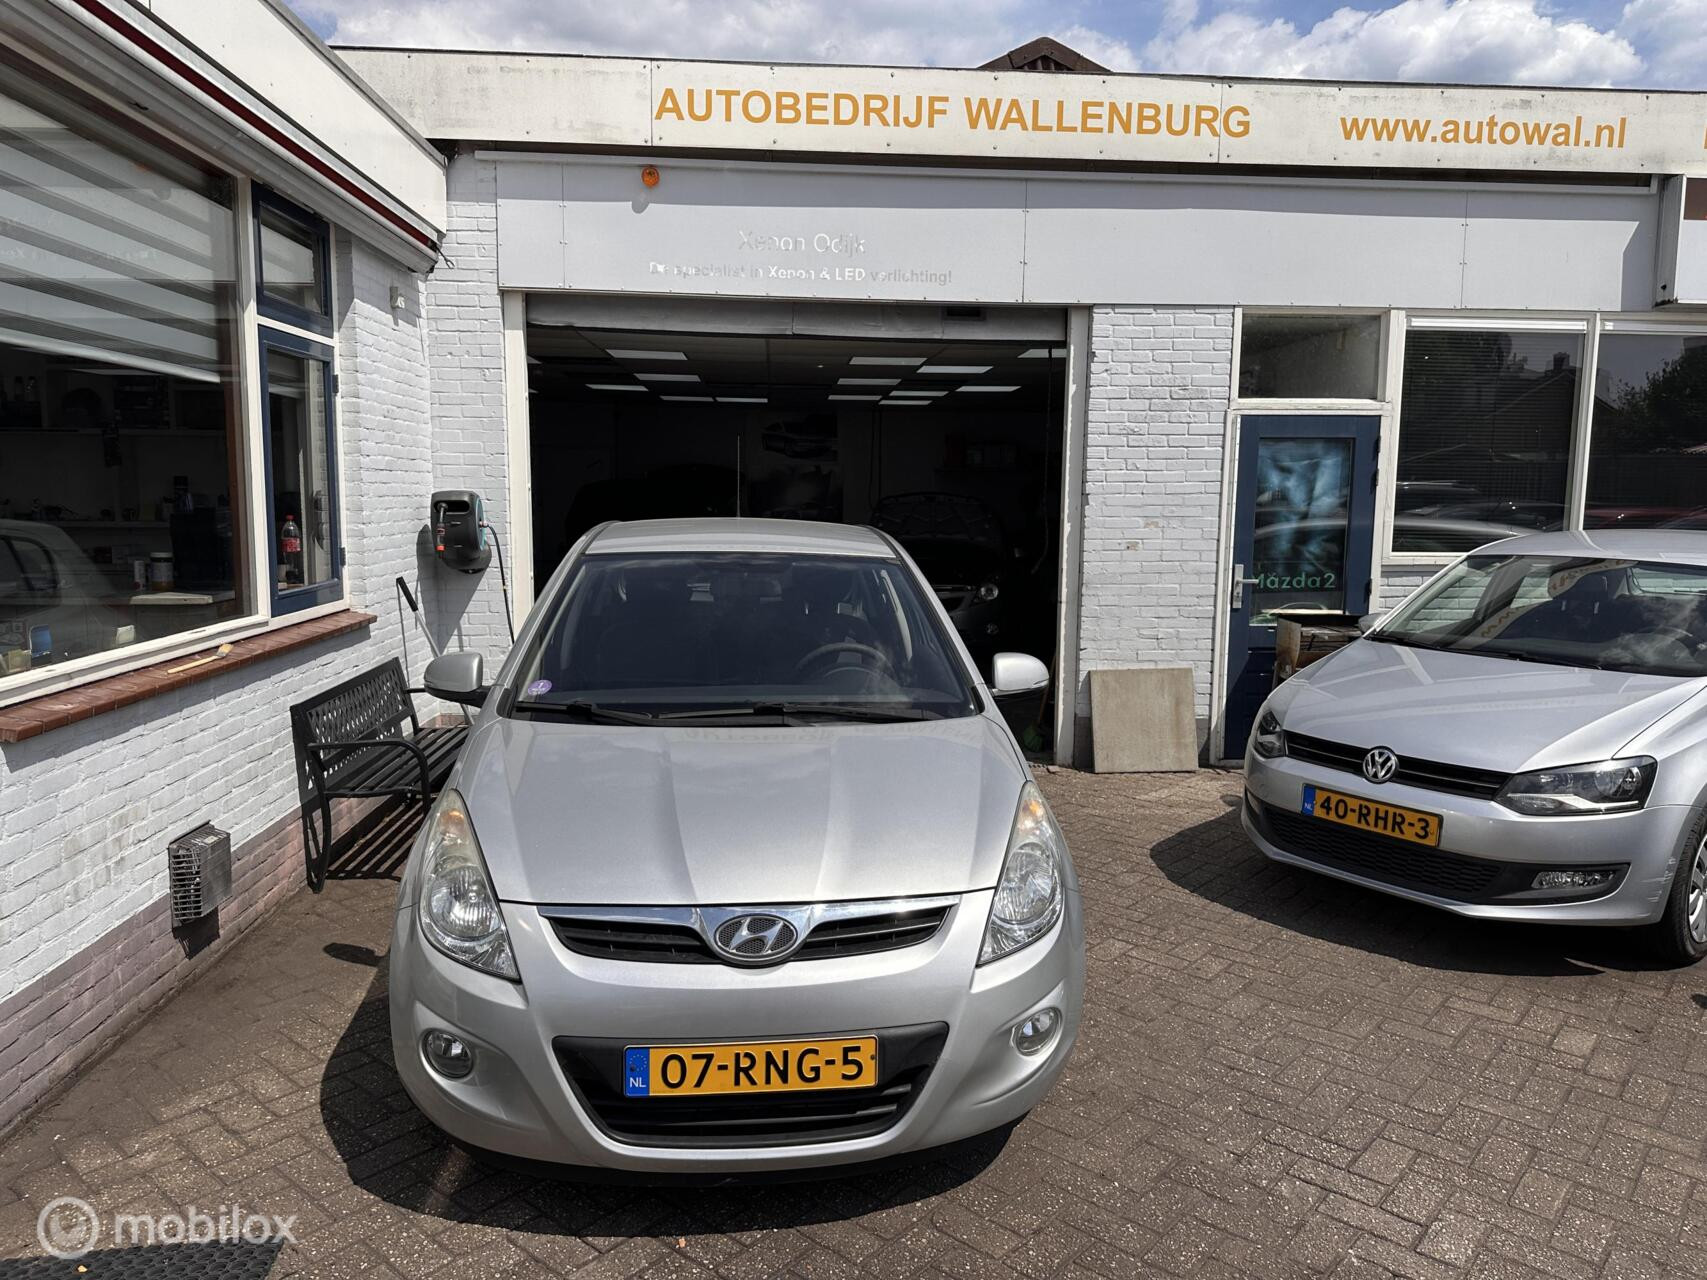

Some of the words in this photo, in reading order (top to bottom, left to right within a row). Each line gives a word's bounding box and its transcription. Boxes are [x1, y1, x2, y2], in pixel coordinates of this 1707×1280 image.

[654, 87, 950, 129] AUTOBEDRIJF
[964, 96, 1252, 138] WALLENBURG
[1340, 114, 1627, 149] www.autowal.nl
[737, 230, 806, 252] Xenon
[768, 265, 815, 280] Xenon
[819, 267, 831, 280] &
[835, 268, 866, 281] LED
[1304, 802, 1313, 812] NL
[1319, 795, 1430, 840] 40-RHR-3
[660, 1045, 864, 1089] 07-RNG-5
[629, 1076, 647, 1089] NL
